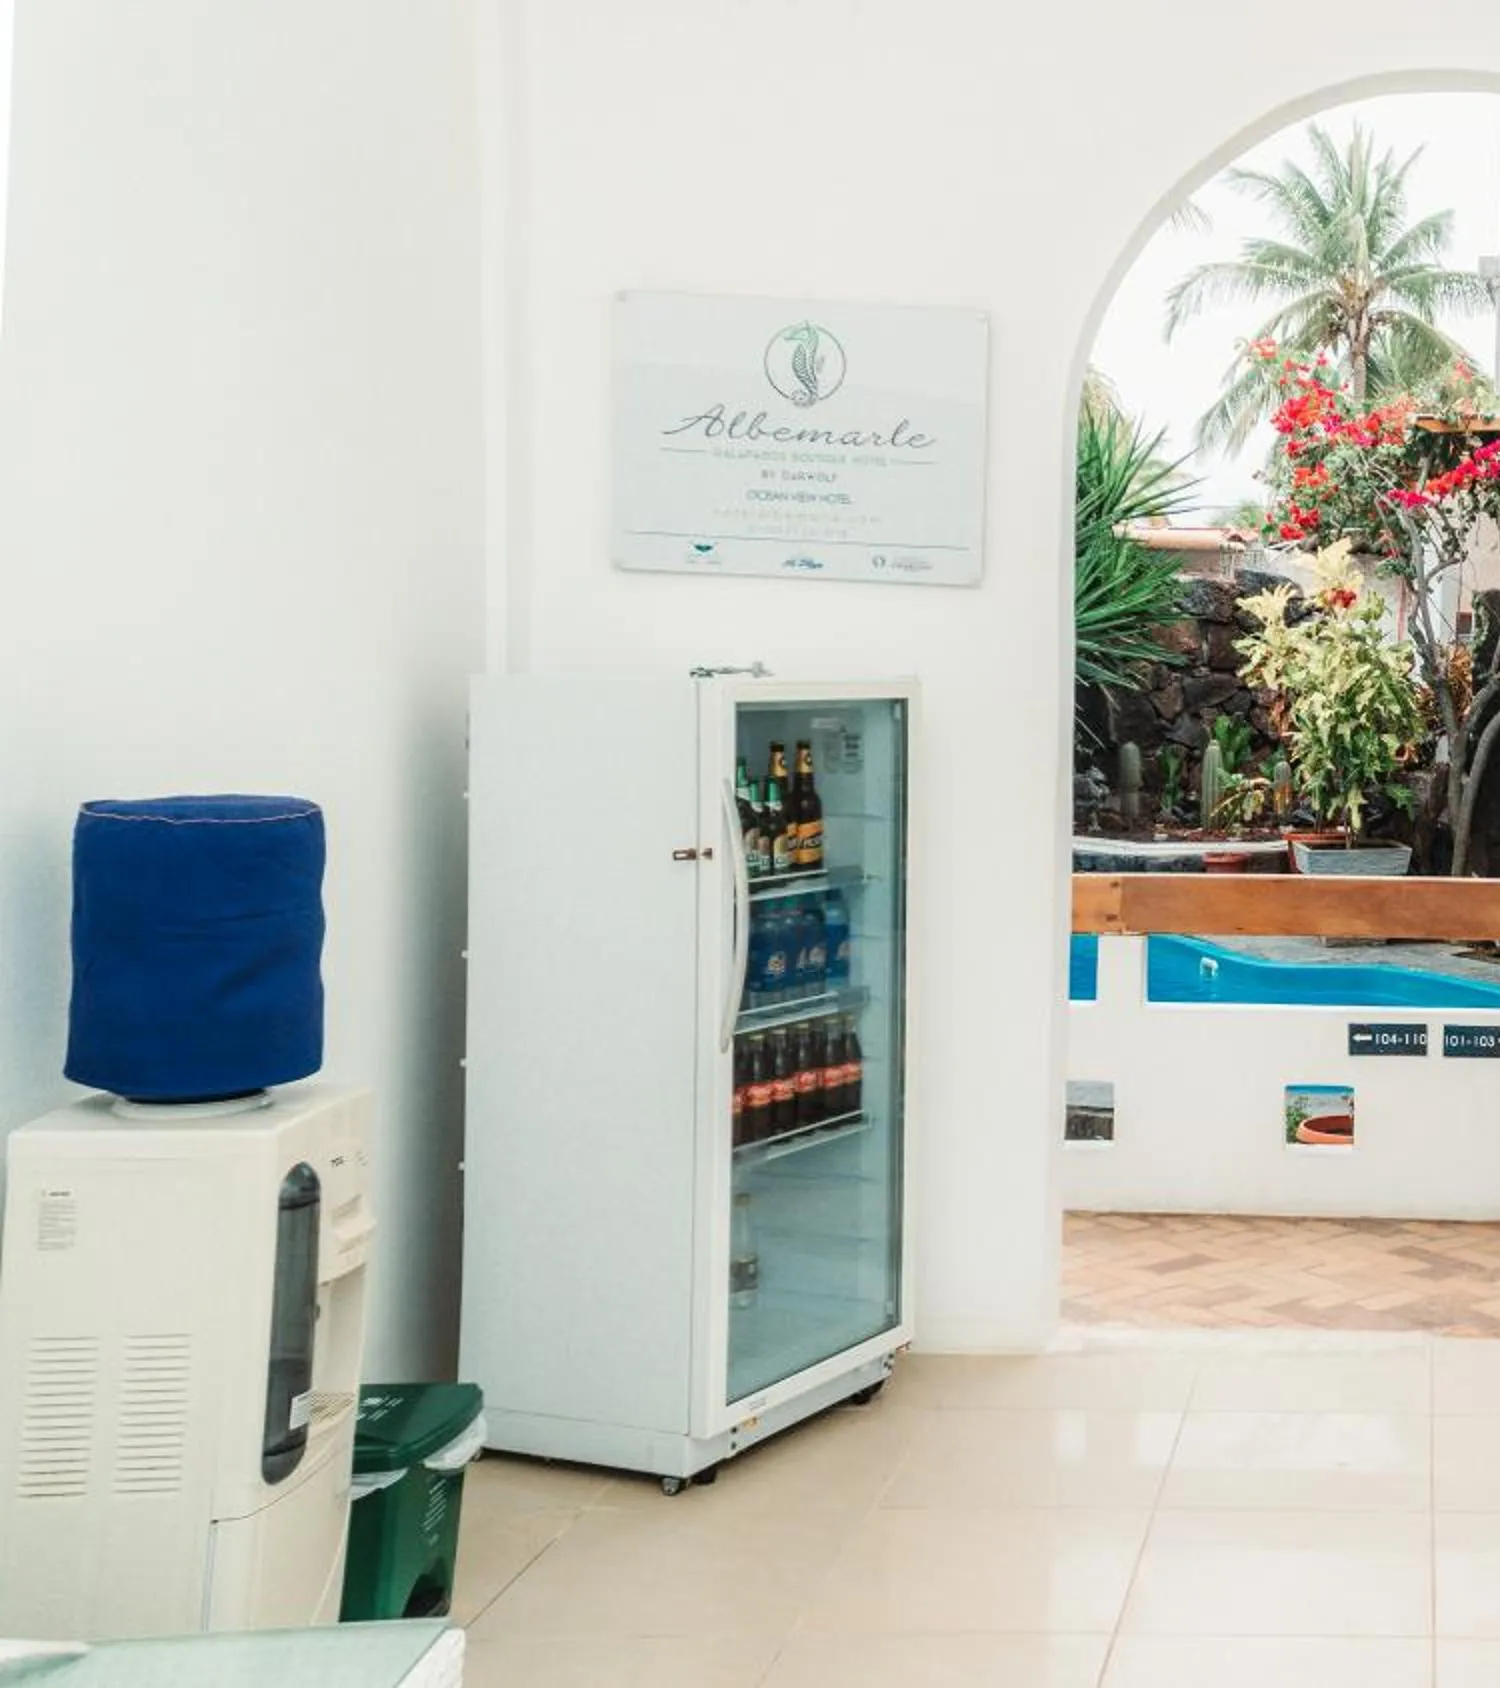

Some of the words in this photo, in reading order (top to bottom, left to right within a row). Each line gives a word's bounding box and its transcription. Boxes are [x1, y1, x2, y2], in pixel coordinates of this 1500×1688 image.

[661, 403, 937, 449] Albemarle
[746, 488, 788, 502] OCEAN
[1375, 1032, 1427, 1046] 104-110
[1445, 1034, 1496, 1048] 101-103
